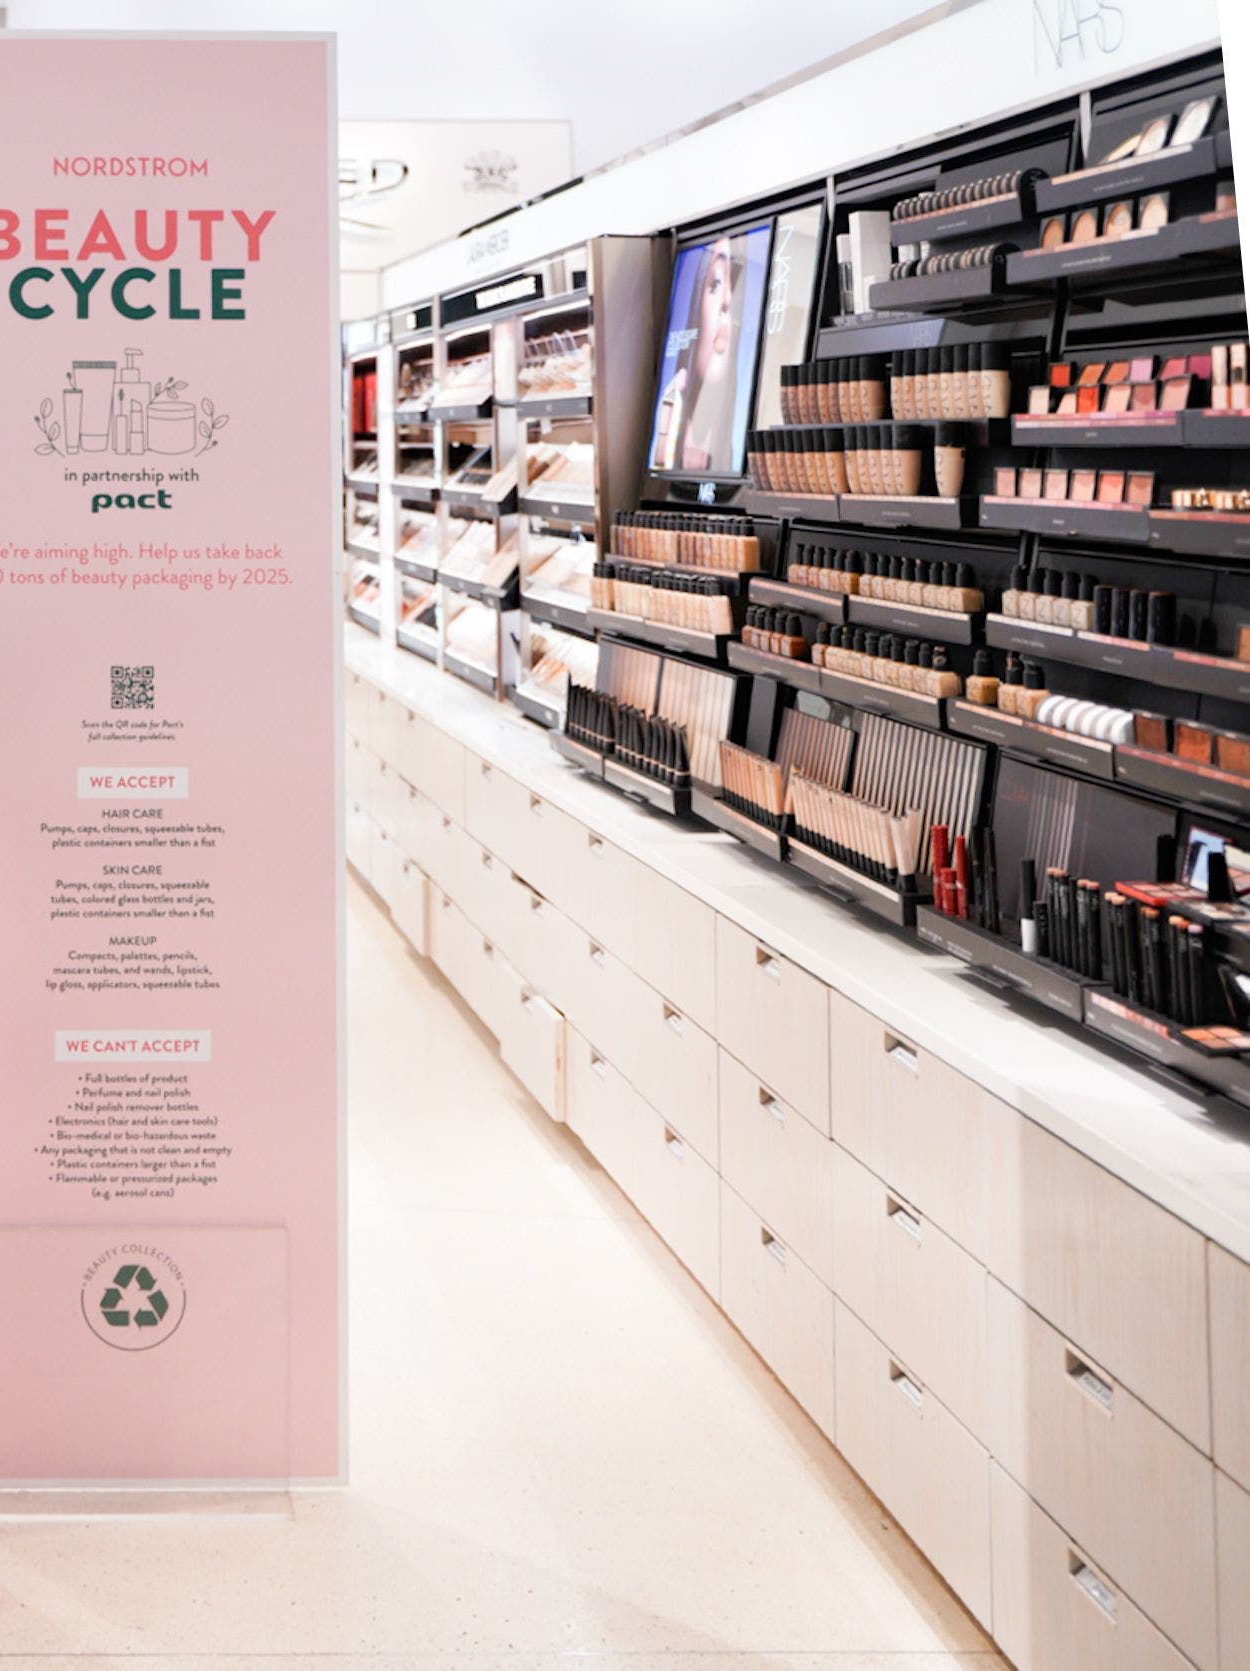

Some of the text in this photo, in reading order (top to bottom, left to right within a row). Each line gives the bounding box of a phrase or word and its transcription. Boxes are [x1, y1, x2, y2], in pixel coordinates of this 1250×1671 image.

[54, 157, 208, 177] NORDSTROM
[9, 267, 246, 320] CYCLE
[65, 468, 199, 485] in partnership with
[91, 489, 172, 513] pact
[35, 543, 89, 565] aiming
[94, 542, 133, 565] high.
[139, 543, 178, 565] Help
[183, 548, 200, 559] us
[206, 543, 240, 559] take
[245, 543, 282, 560] back
[10, 572, 44, 584] tons
[50, 568, 66, 584] of
[72, 568, 127, 590] beauty
[133, 568, 213, 590] packaging
[218, 568, 237, 590] by
[243, 568, 293, 585] 2025.
[90, 776, 175, 788] WE ACCEPT
[102, 809, 163, 819] HAIR CARE
[40, 823, 225, 835] Pumps, caps, closures, squeezable tubes,
[52, 838, 80, 849] plastic
[134, 838, 167, 847] smaller
[170, 838, 190, 847] than
[201, 838, 215, 847] fist
[103, 865, 162, 875] SKIN CARE
[55, 880, 209, 891] Pumps, caps, closures, squeezable
[51, 895, 214, 907] tubes, colored glass bottles and jars,
[51, 909, 80, 920] plastic
[82, 909, 131, 918] containers
[133, 909, 166, 918] smaller
[168, 909, 189, 918] than
[200, 909, 214, 918] fist
[109, 937, 157, 946] MAKEUP
[68, 950, 197, 962] Compacts, palettes, pencils,
[93, 966, 121, 975] tubes,
[124, 966, 140, 974] and
[143, 965, 174, 975] wands,
[177, 965, 212, 975] lipstick,
[46, 980, 220, 992] lip gloss, applicators, squeezable tubes
[66, 1040, 200, 1052] WE CAN'T ACCEPT
[85, 1073, 187, 1084] Full bottles of product
[83, 1088, 190, 1098] Perfume and nail polish
[75, 1102, 93, 1112] Nail
[96, 1102, 123, 1113] polish
[167, 1102, 198, 1112] bottles
[55, 1117, 105, 1126] Electronics
[108, 1117, 129, 1126] (hair
[132, 1117, 148, 1126] and
[150, 1117, 168, 1126] skin
[192, 1117, 218, 1126] tools)
[57, 1132, 111, 1140] Bio-medical
[125, 1132, 188, 1140] bio-hazardous
[191, 1132, 216, 1140] waste
[41, 1145, 60, 1157] Any
[62, 1146, 107, 1157] packaging
[110, 1145, 128, 1154] that
[131, 1146, 138, 1154] is
[158, 1145, 181, 1154] clean
[184, 1145, 200, 1154] and
[203, 1146, 232, 1157] empty
[58, 1160, 87, 1169] Plastic
[90, 1160, 138, 1169] containers
[141, 1160, 167, 1170] larger
[170, 1160, 190, 1169] than
[201, 1160, 216, 1168] fist
[56, 1174, 106, 1184] Flammable
[122, 1174, 173, 1186] pressurized
[176, 1174, 217, 1186] packages
[92, 1188, 174, 1199] (e.g. aerosol cans)
[83, 1243, 183, 1282] BEAUTY COLLECTION
